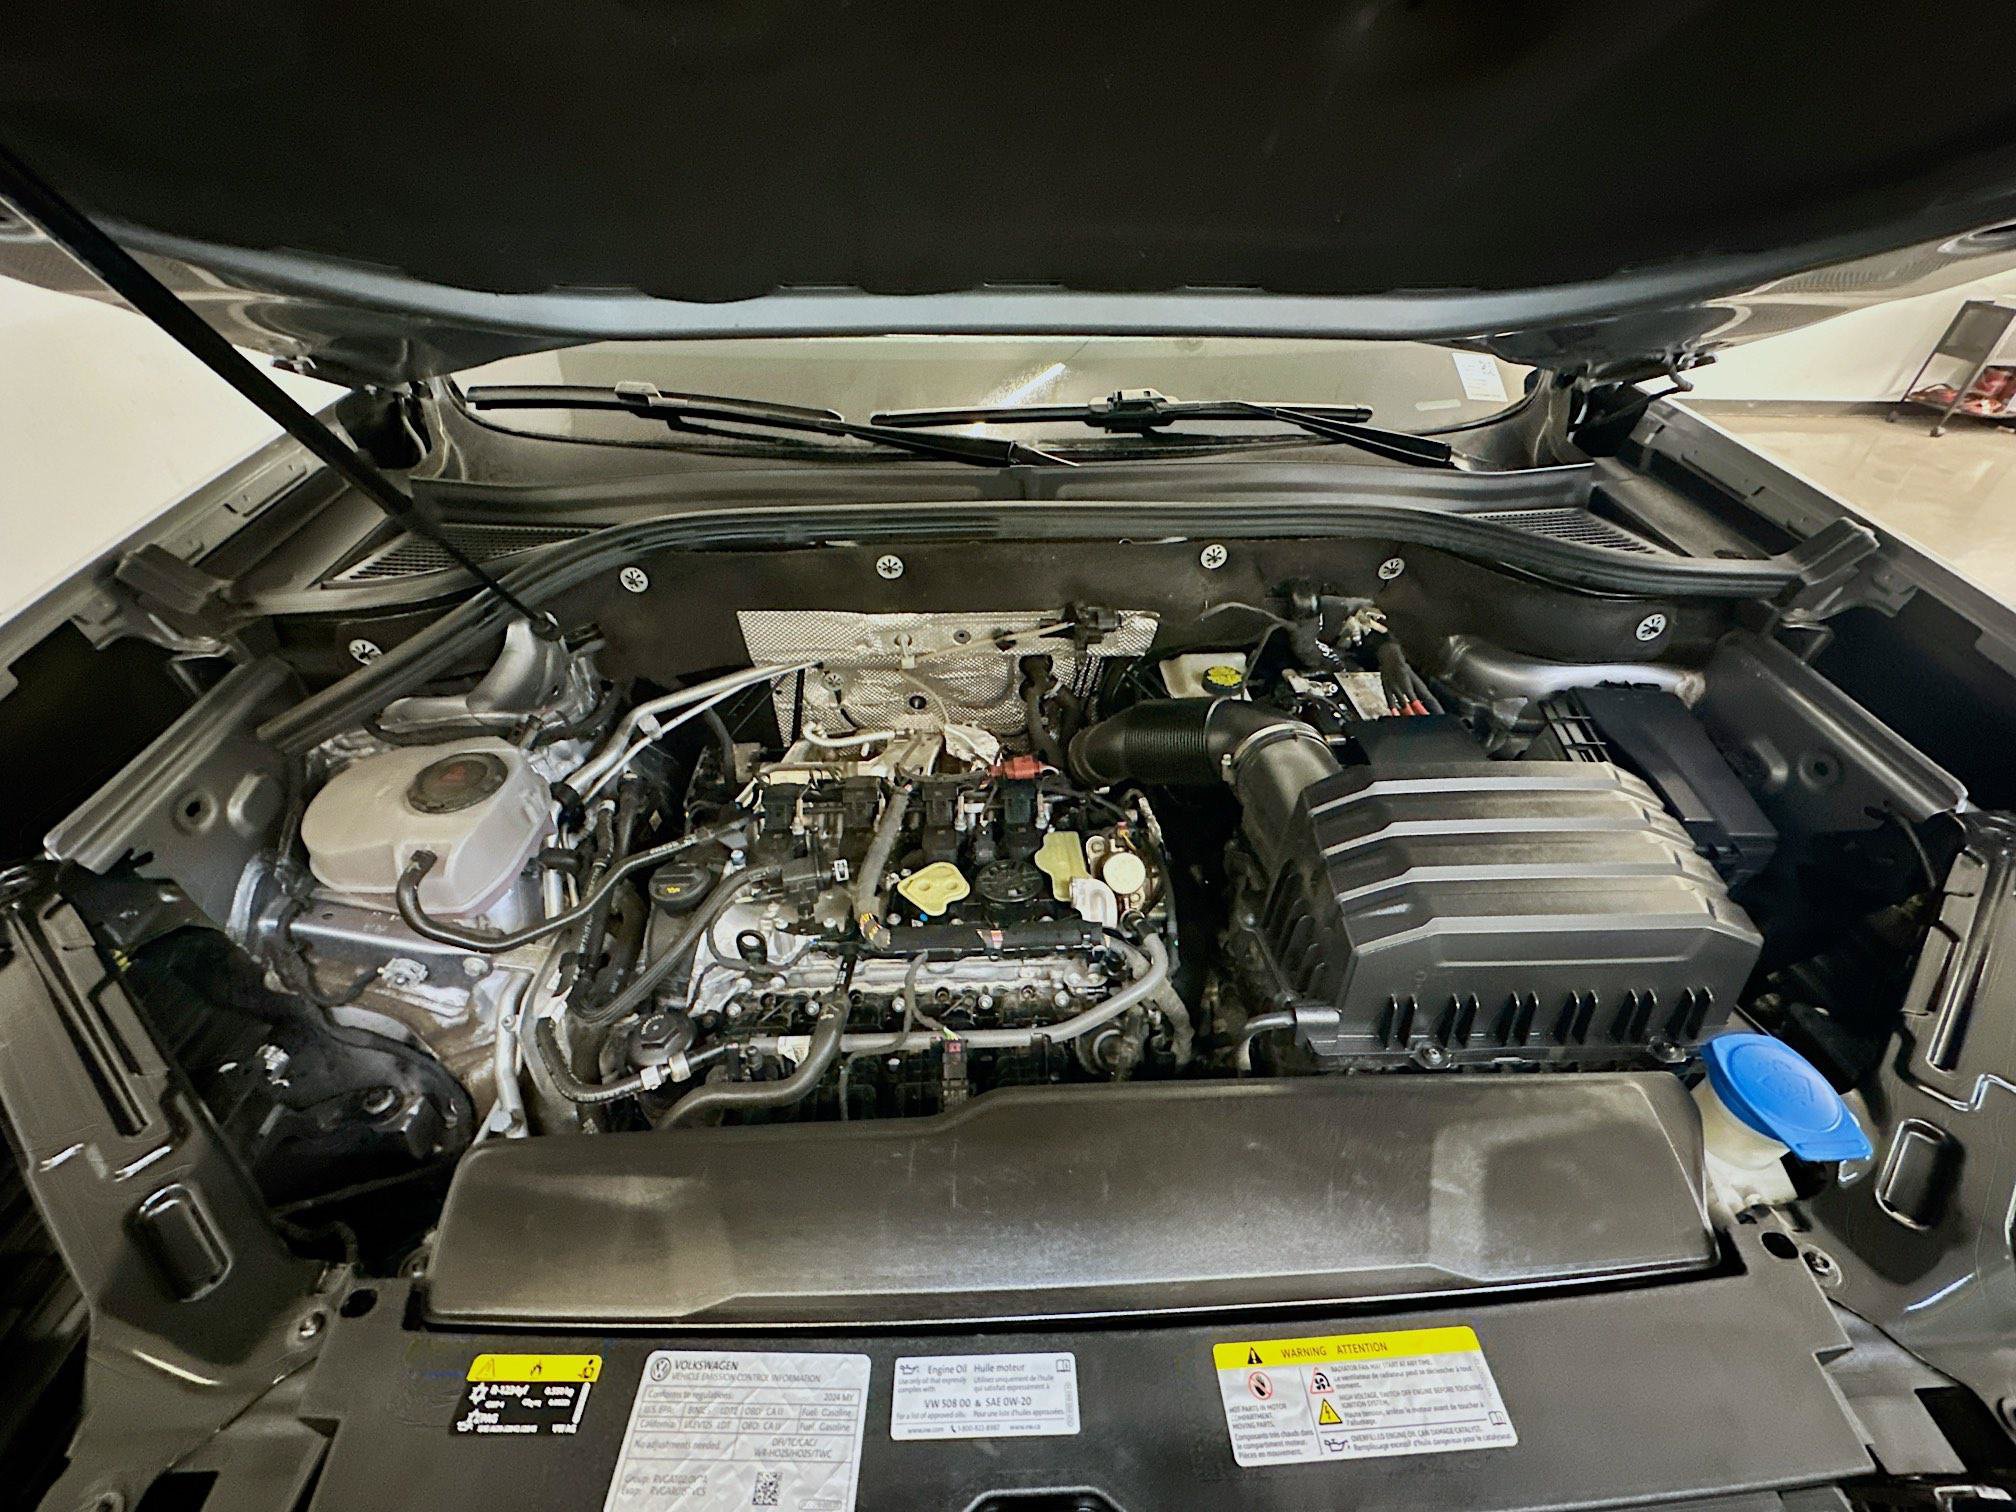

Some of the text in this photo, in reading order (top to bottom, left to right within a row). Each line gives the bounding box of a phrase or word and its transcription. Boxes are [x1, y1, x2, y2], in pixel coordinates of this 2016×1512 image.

[1280, 1341, 1389, 1360] WARNING ATTENTION
[674, 1360, 739, 1371] VOLKSWAGEN
[927, 1363, 968, 1376] Engine Oil
[974, 1362, 1025, 1372] Huile moteur
[771, 1373, 821, 1383] INFORMATION
[924, 1398, 940, 1408] VW
[941, 1398, 958, 1408] 508
[958, 1397, 972, 1408] 00
[985, 1397, 1001, 1407] SAE
